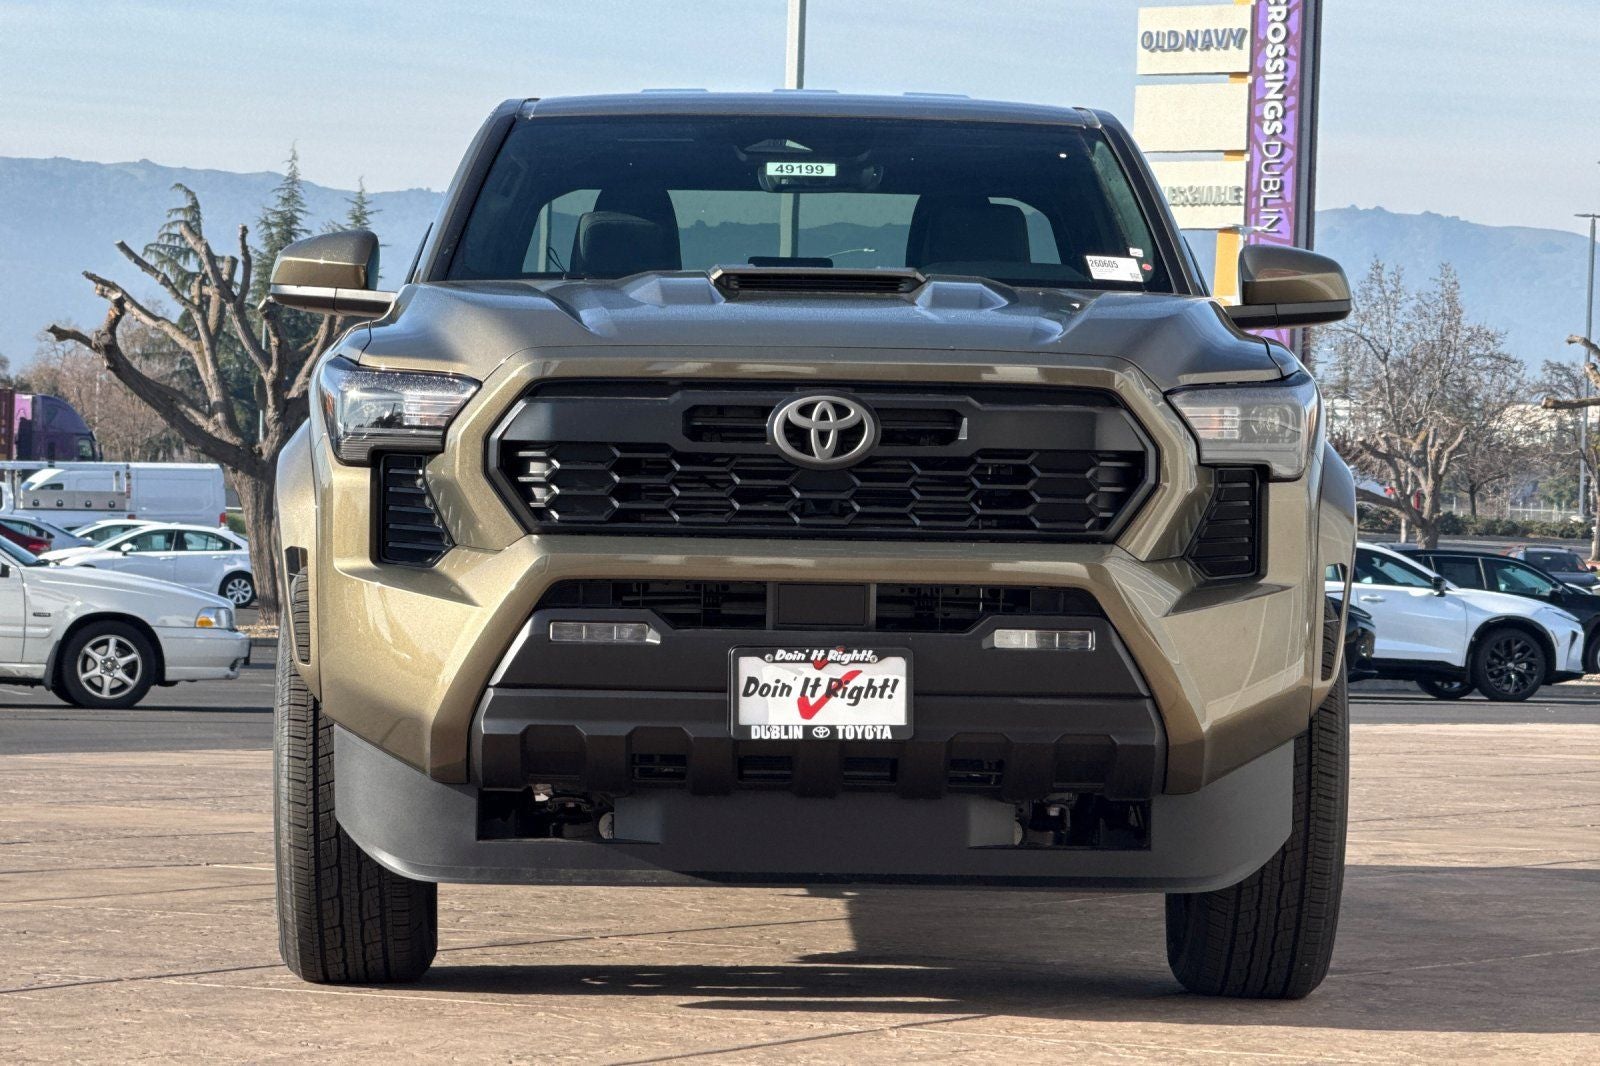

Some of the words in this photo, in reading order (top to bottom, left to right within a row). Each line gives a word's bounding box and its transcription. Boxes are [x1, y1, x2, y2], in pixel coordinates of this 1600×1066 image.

[1141, 30, 1183, 52] OLD
[1186, 28, 1247, 51] NAVY
[1263, 0, 1288, 135] ROSSINGS
[774, 164, 825, 175] 49199
[1260, 141, 1283, 233] DUBLIN
[775, 649, 809, 660] Doin'
[810, 649, 825, 660] It
[827, 649, 873, 665] Right!
[742, 675, 797, 697] Doin'
[800, 677, 822, 697] It
[826, 677, 900, 706] Right!
[751, 725, 803, 739] DUBLIN
[836, 725, 893, 739] TOYOTA
